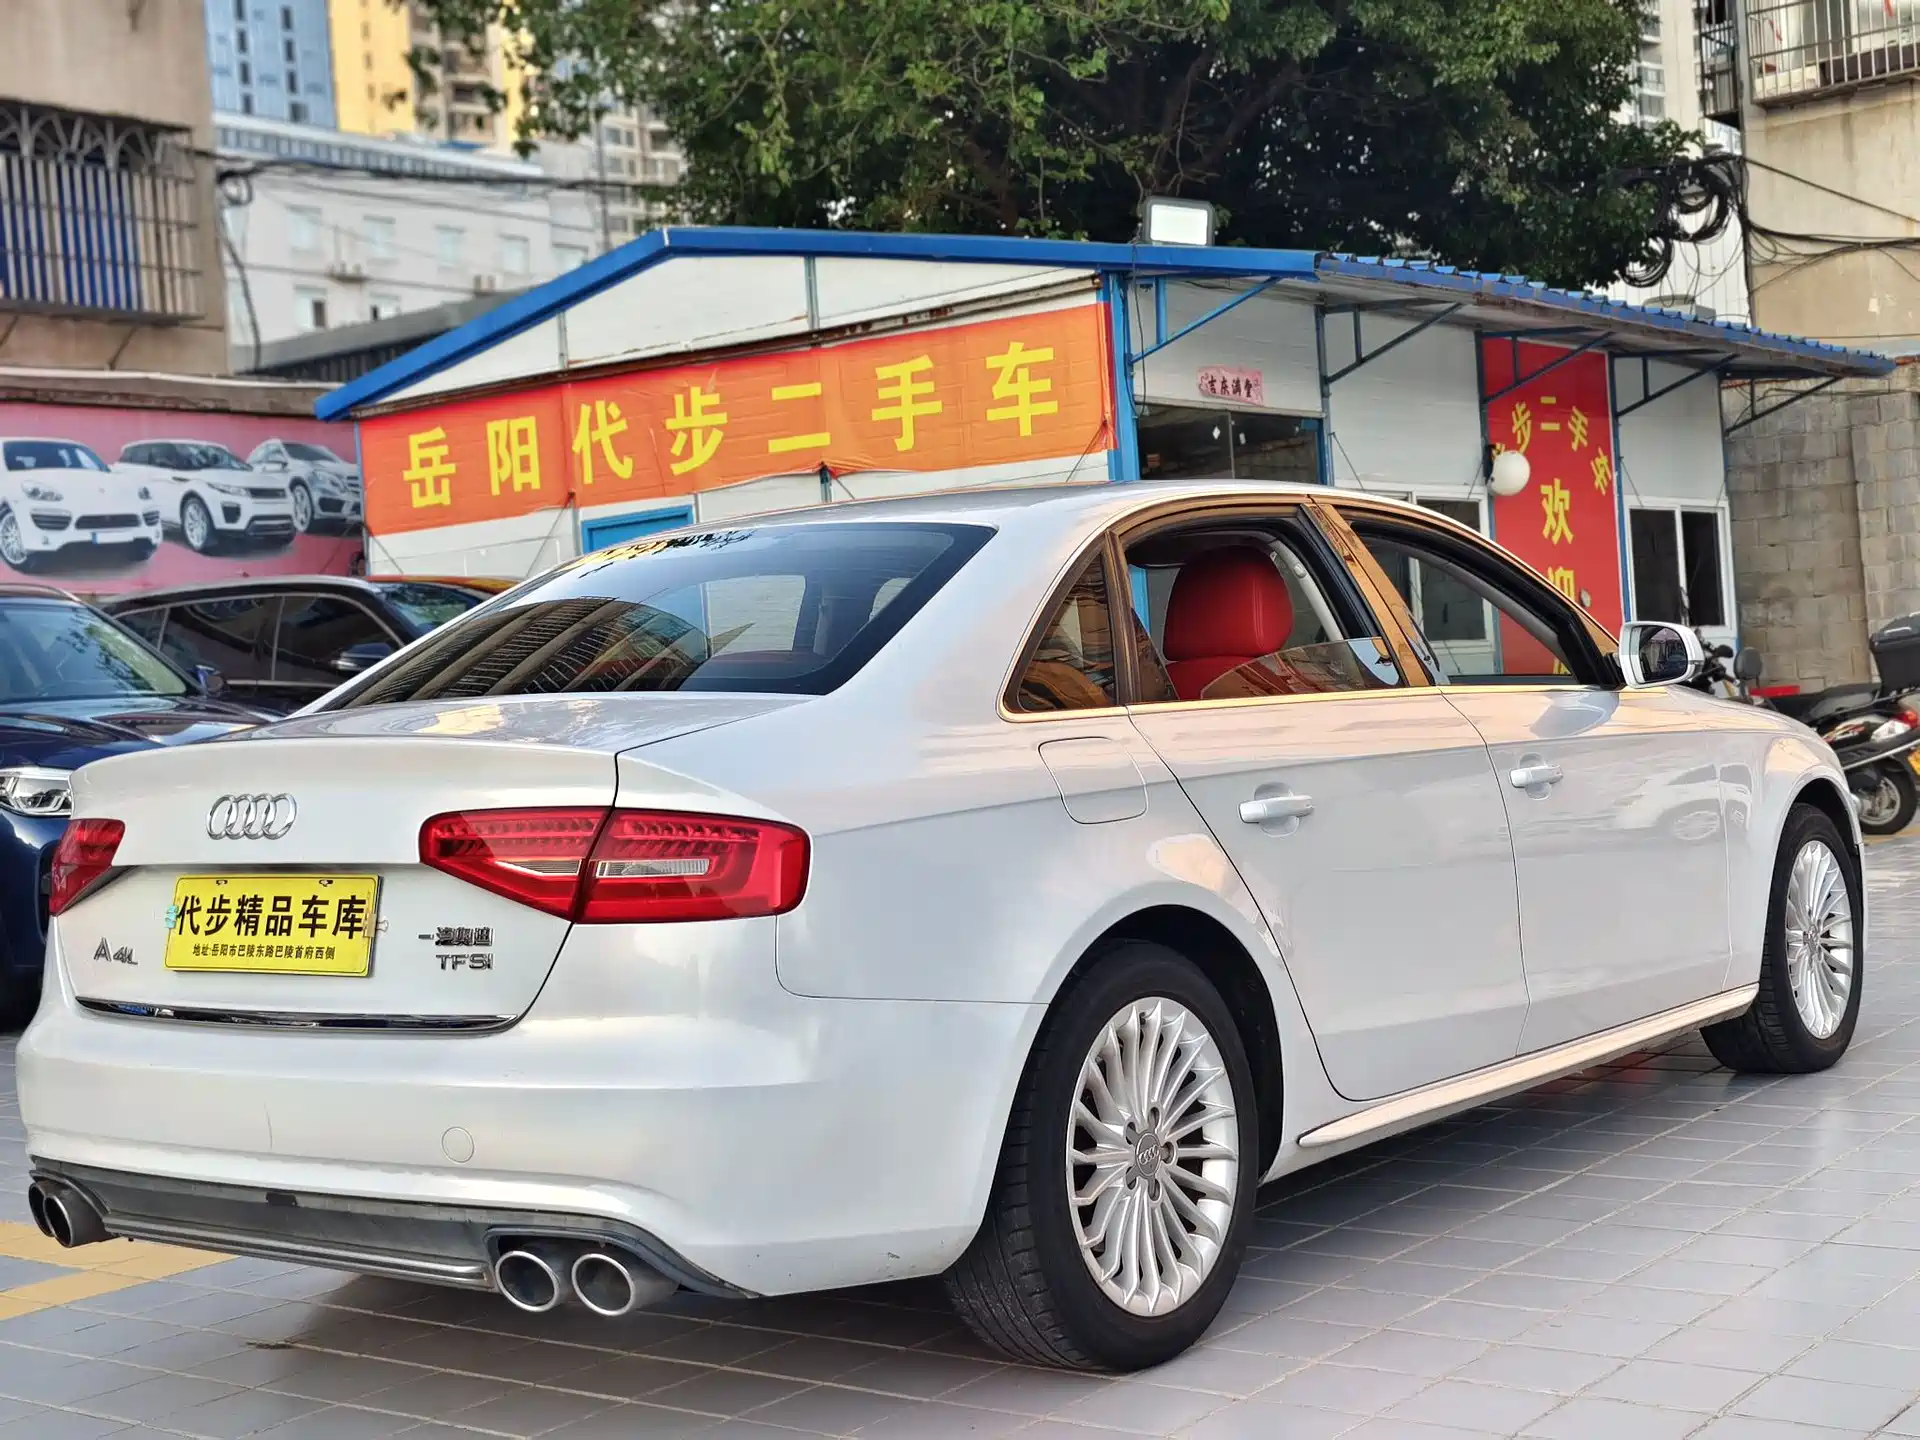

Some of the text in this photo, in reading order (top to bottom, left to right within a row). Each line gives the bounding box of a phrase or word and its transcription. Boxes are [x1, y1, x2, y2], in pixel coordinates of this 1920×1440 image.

[402, 340, 1059, 509] 岳阳代步二手车
[178, 894, 366, 939] 代步精品车库
[93, 936, 139, 965] A4L
[435, 952, 494, 970] TFSI
